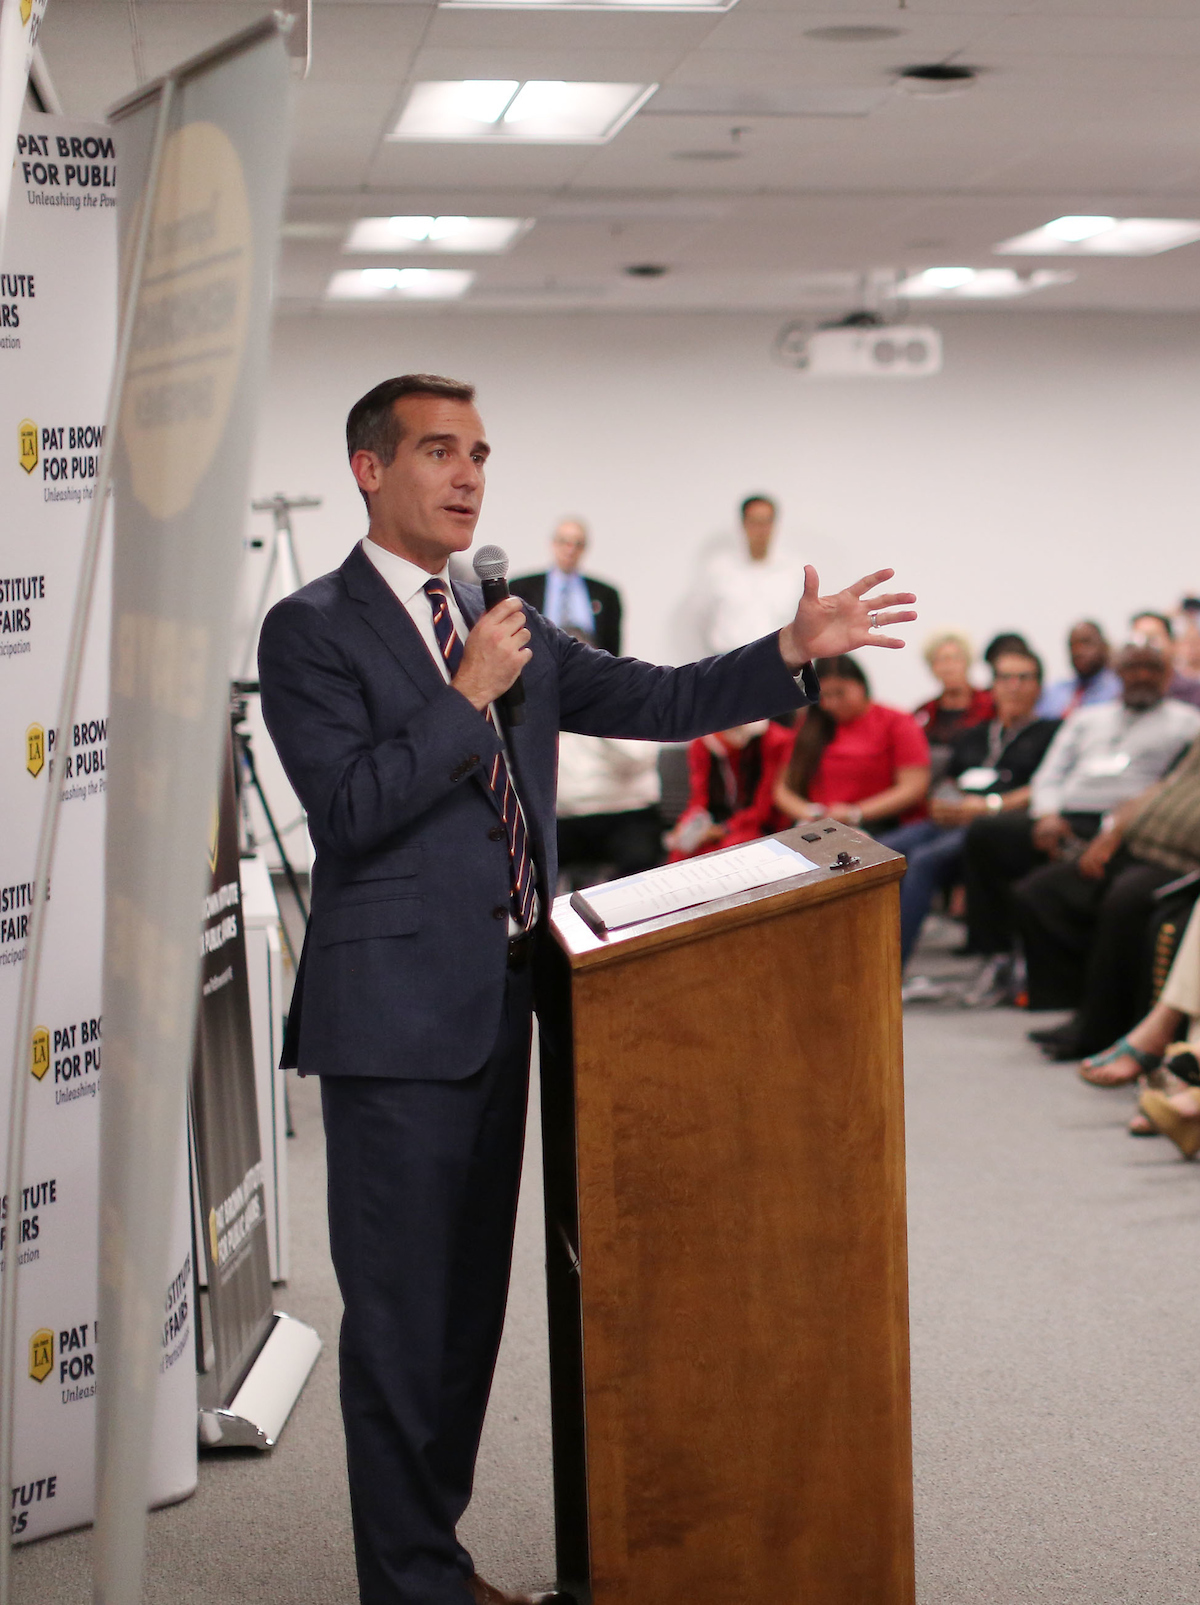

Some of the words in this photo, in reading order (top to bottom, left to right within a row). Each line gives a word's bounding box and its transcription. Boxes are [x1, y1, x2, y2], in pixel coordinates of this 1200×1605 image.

[17, 133, 48, 157] PAT
[56, 136, 115, 159] BROW
[22, 161, 60, 187] FOR
[27, 190, 80, 211] Unleashing
[83, 192, 97, 208] the
[42, 426, 64, 451] PAT
[43, 457, 68, 481] FOR
[44, 485, 82, 504] Unleashing
[48, 756, 73, 784] FR
[54, 1024, 77, 1054] PAT
[55, 1053, 81, 1084] FOR
[55, 1080, 97, 1106] Unleashing
[60, 1323, 88, 1355] PAT
[60, 1353, 95, 1385] FOR
